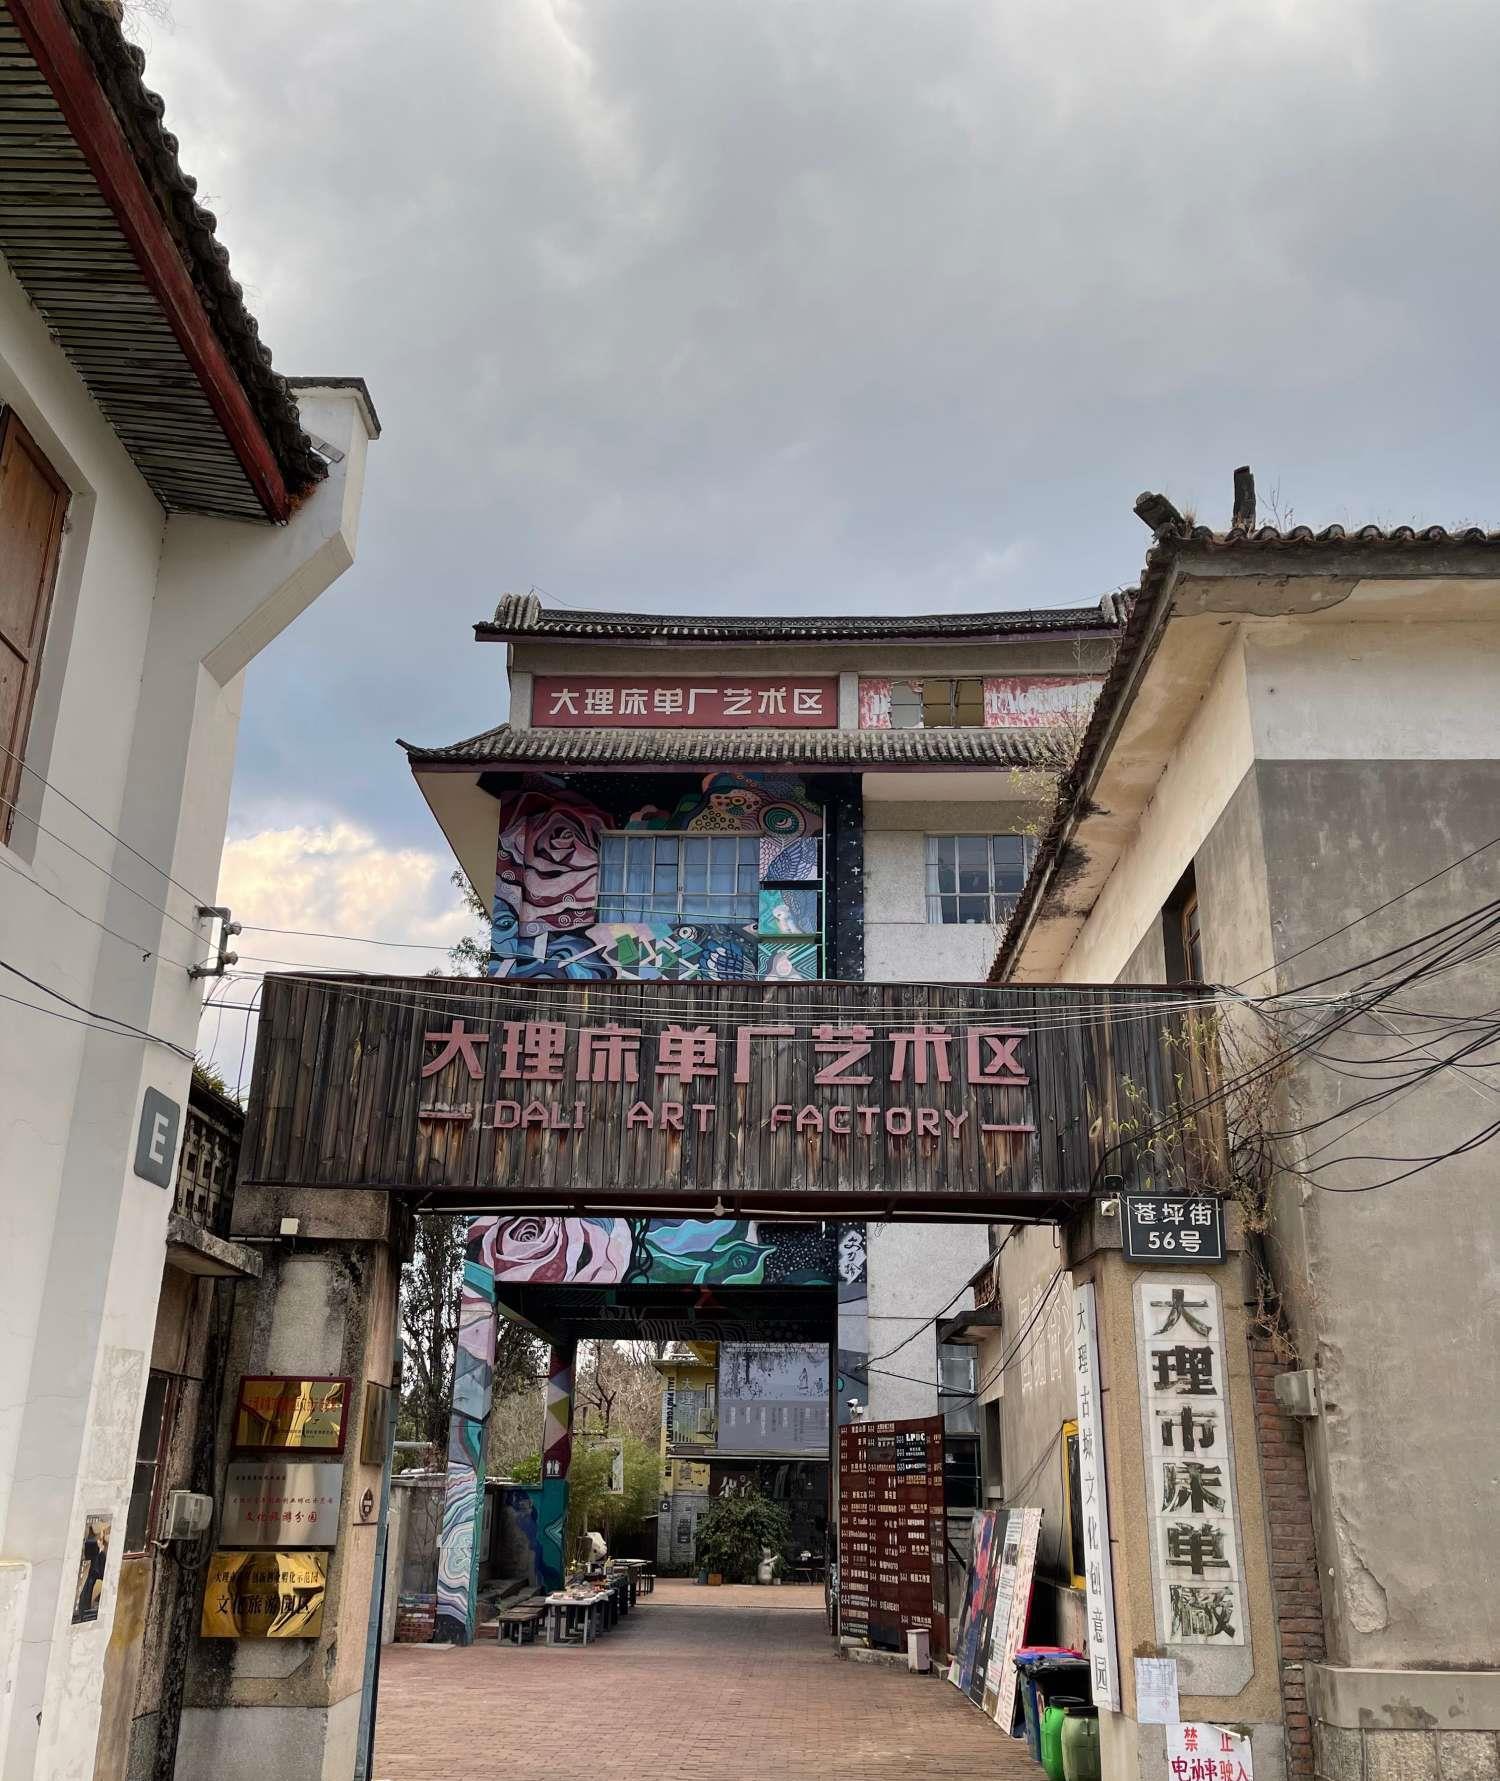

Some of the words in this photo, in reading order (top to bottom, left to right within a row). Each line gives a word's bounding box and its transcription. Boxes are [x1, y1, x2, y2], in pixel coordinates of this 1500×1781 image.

[549, 688, 823, 714] 大理床单厂艺术区
[421, 1019, 1030, 1085] 大理床单厂艺术区
[493, 1100, 586, 1129] DALI
[626, 1101, 716, 1131] ART
[770, 1104, 969, 1138] FACTORY
[149, 1111, 170, 1164] E
[1134, 1202, 1212, 1225] 苍坪街
[1148, 1230, 1202, 1253] 56号
[1183, 1726, 1234, 1752] 禁止
